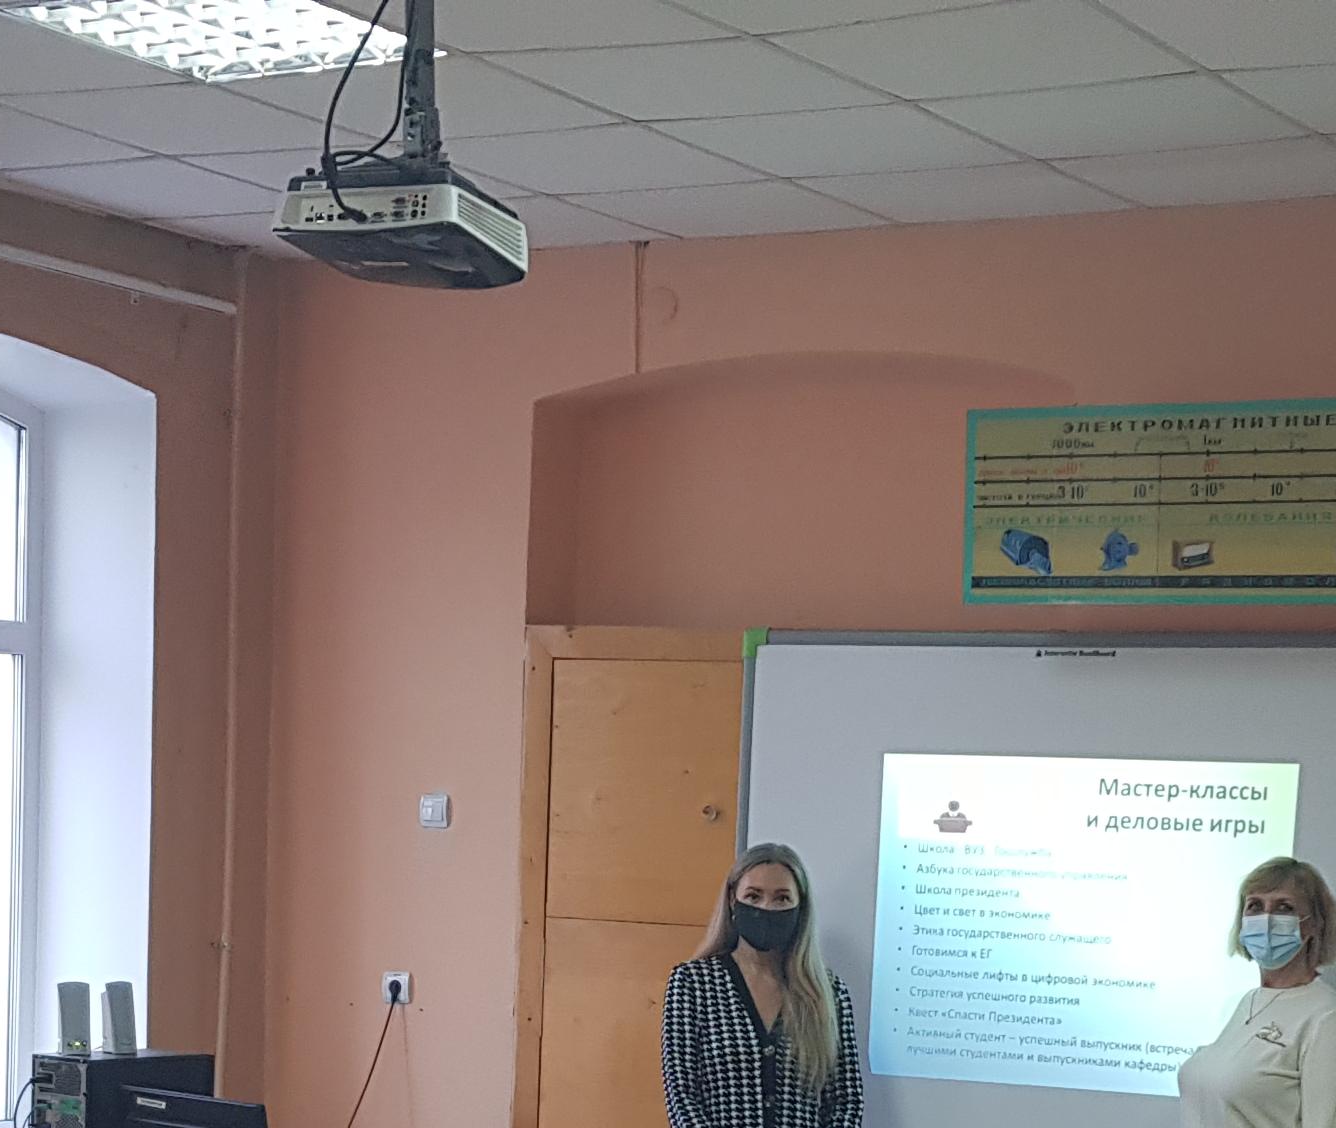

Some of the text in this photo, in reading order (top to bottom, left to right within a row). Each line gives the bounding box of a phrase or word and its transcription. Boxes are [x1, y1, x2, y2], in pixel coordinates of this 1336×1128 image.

[1098, 777, 1268, 803] Мастер-классы
[1086, 814, 1266, 839] и деловые игры
[917, 844, 954, 854] Школа
[916, 864, 954, 877] Азбука
[915, 884, 1020, 900] Школа президента
[914, 904, 1052, 921] Цвет и свет в экономике
[912, 924, 944, 937] Этика
[947, 927, 1046, 943] государственного
[911, 945, 968, 958] Готовимся
[971, 949, 978, 958] к
[910, 965, 1156, 990] Социальные лифты в цифровой экономике
[909, 985, 1080, 1006] Стратегия успешного развития
[908, 1006, 1063, 1026] Квест «Спасти Президента»
[906, 1026, 962, 1040] Активный
[964, 1032, 1006, 1044] студент
[1018, 1035, 1077, 1048] успешный
[1080, 1039, 1142, 1052] выпускник
[906, 1045, 956, 1056] лучшими
[959, 1047, 1023, 1061] студентами
[1027, 1053, 1034, 1061] и
[1037, 1053, 1121, 1068] выпускниками
